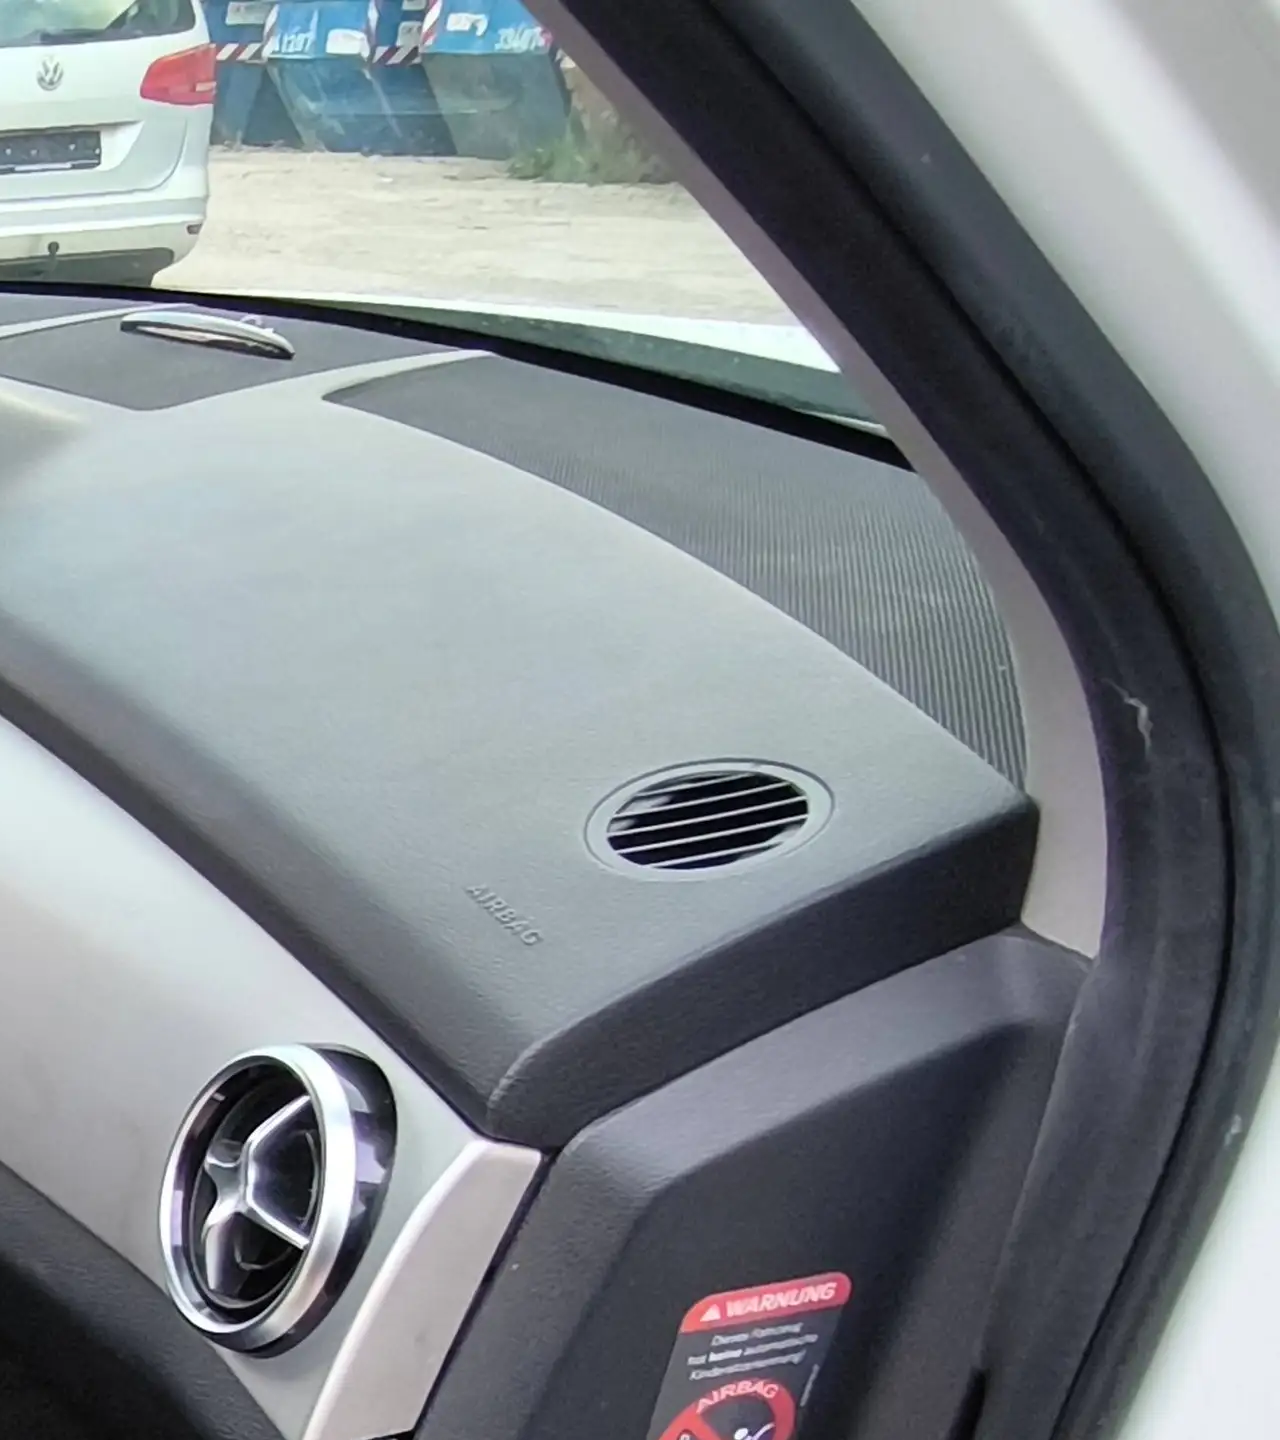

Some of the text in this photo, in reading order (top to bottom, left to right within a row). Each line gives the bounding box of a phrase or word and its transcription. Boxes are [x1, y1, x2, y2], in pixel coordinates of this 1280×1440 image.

[466, 884, 543, 946] AIRBAG
[726, 1282, 837, 1318] WARNUNG
[696, 1379, 779, 1414] AIRBAG
